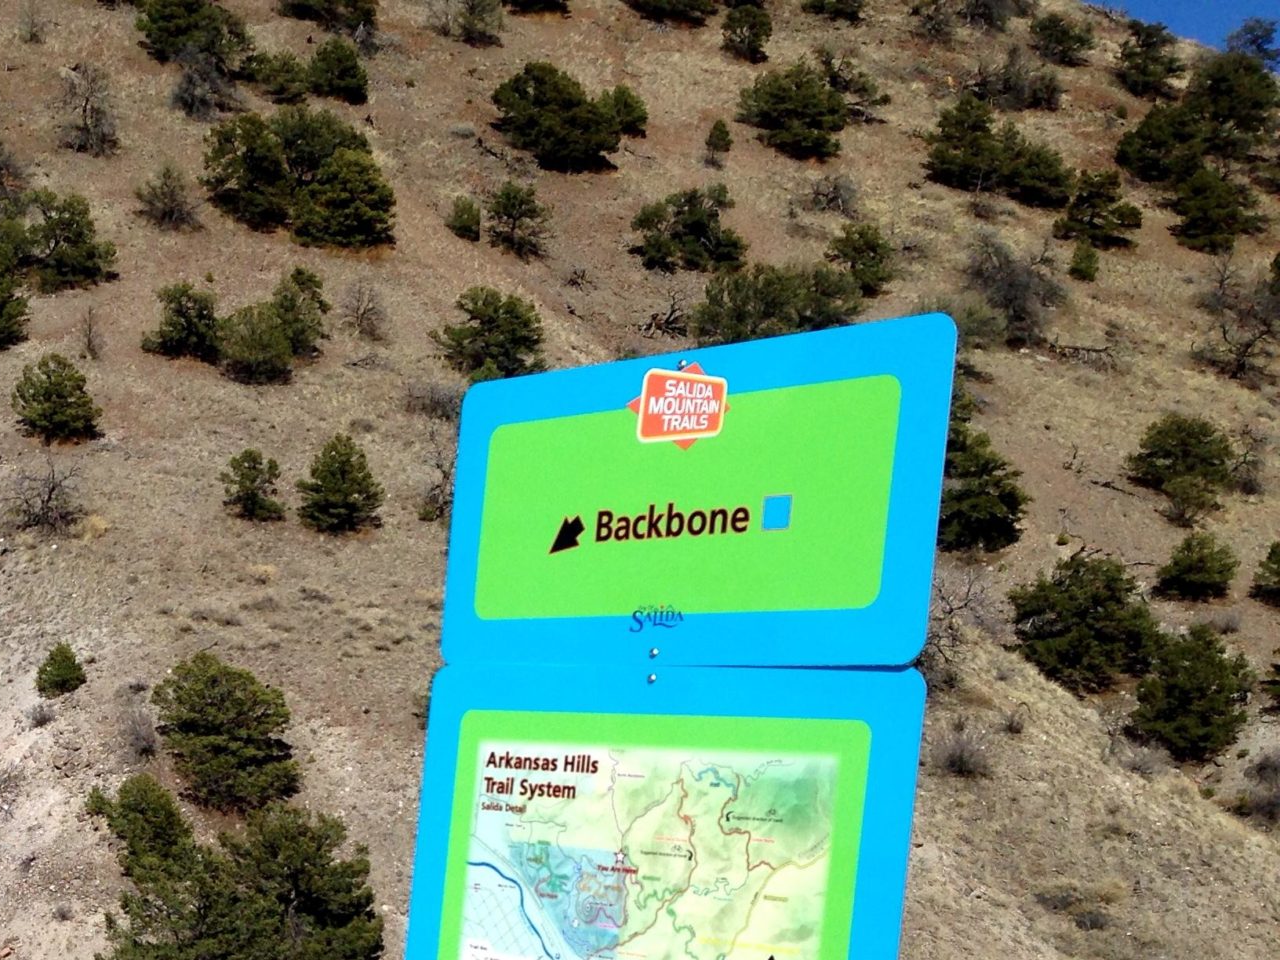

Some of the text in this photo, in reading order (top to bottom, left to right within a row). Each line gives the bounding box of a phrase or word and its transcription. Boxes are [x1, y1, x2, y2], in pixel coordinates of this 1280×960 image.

[664, 379, 713, 398] SALIDA
[648, 396, 720, 415] MOUNTAIN
[662, 414, 709, 432] TRAILS
[594, 502, 750, 543] Backbone
[485, 751, 599, 774] Arkansas Hills
[484, 777, 576, 800] Trail System
[481, 801, 527, 814] Salida Detail
